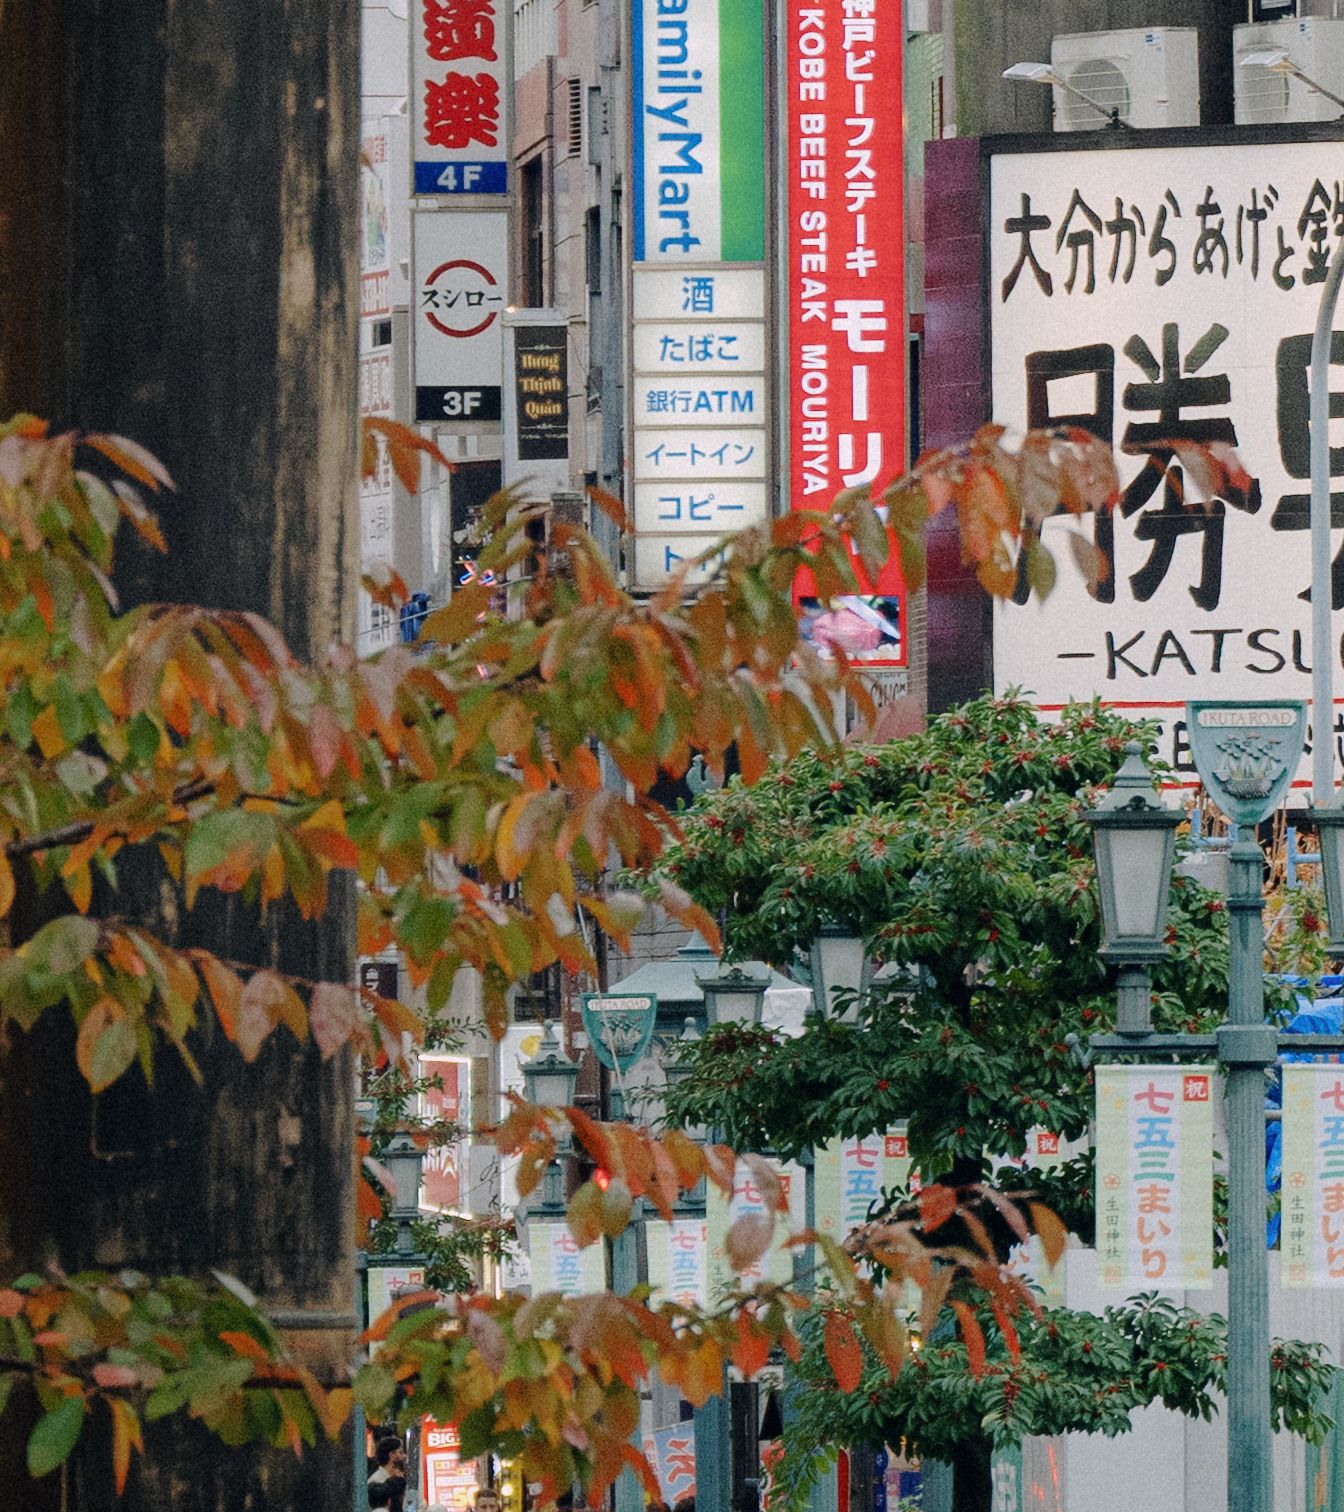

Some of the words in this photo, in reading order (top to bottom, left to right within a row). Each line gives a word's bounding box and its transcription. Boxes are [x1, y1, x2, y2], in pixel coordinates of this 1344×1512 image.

[799, 9, 826, 101] KOBE
[799, 114, 827, 200] BEEF
[436, 165, 481, 190] 4F
[800, 211, 828, 323] STEAK
[420, 286, 503, 310] スシロー
[681, 277, 714, 314] 酒
[659, 334, 740, 363] たばこ
[441, 390, 480, 415] 3F
[646, 389, 754, 414] 銀行ATM
[801, 344, 829, 496] MOURIYA
[832, 298, 889, 557] モーリ
[645, 443, 755, 466] イートイン
[658, 493, 744, 521] コピー
[1203, 712, 1245, 726] IKUTA
[1247, 712, 1292, 726] ROAD
[1185, 1077, 1207, 1099] 祝
[1133, 1081, 1176, 1279] 七五三まいり
[1104, 1195, 1121, 1260] 生田神社
[1289, 1195, 1306, 1258] 生田神社
[427, 1432, 455, 1448] BIG
